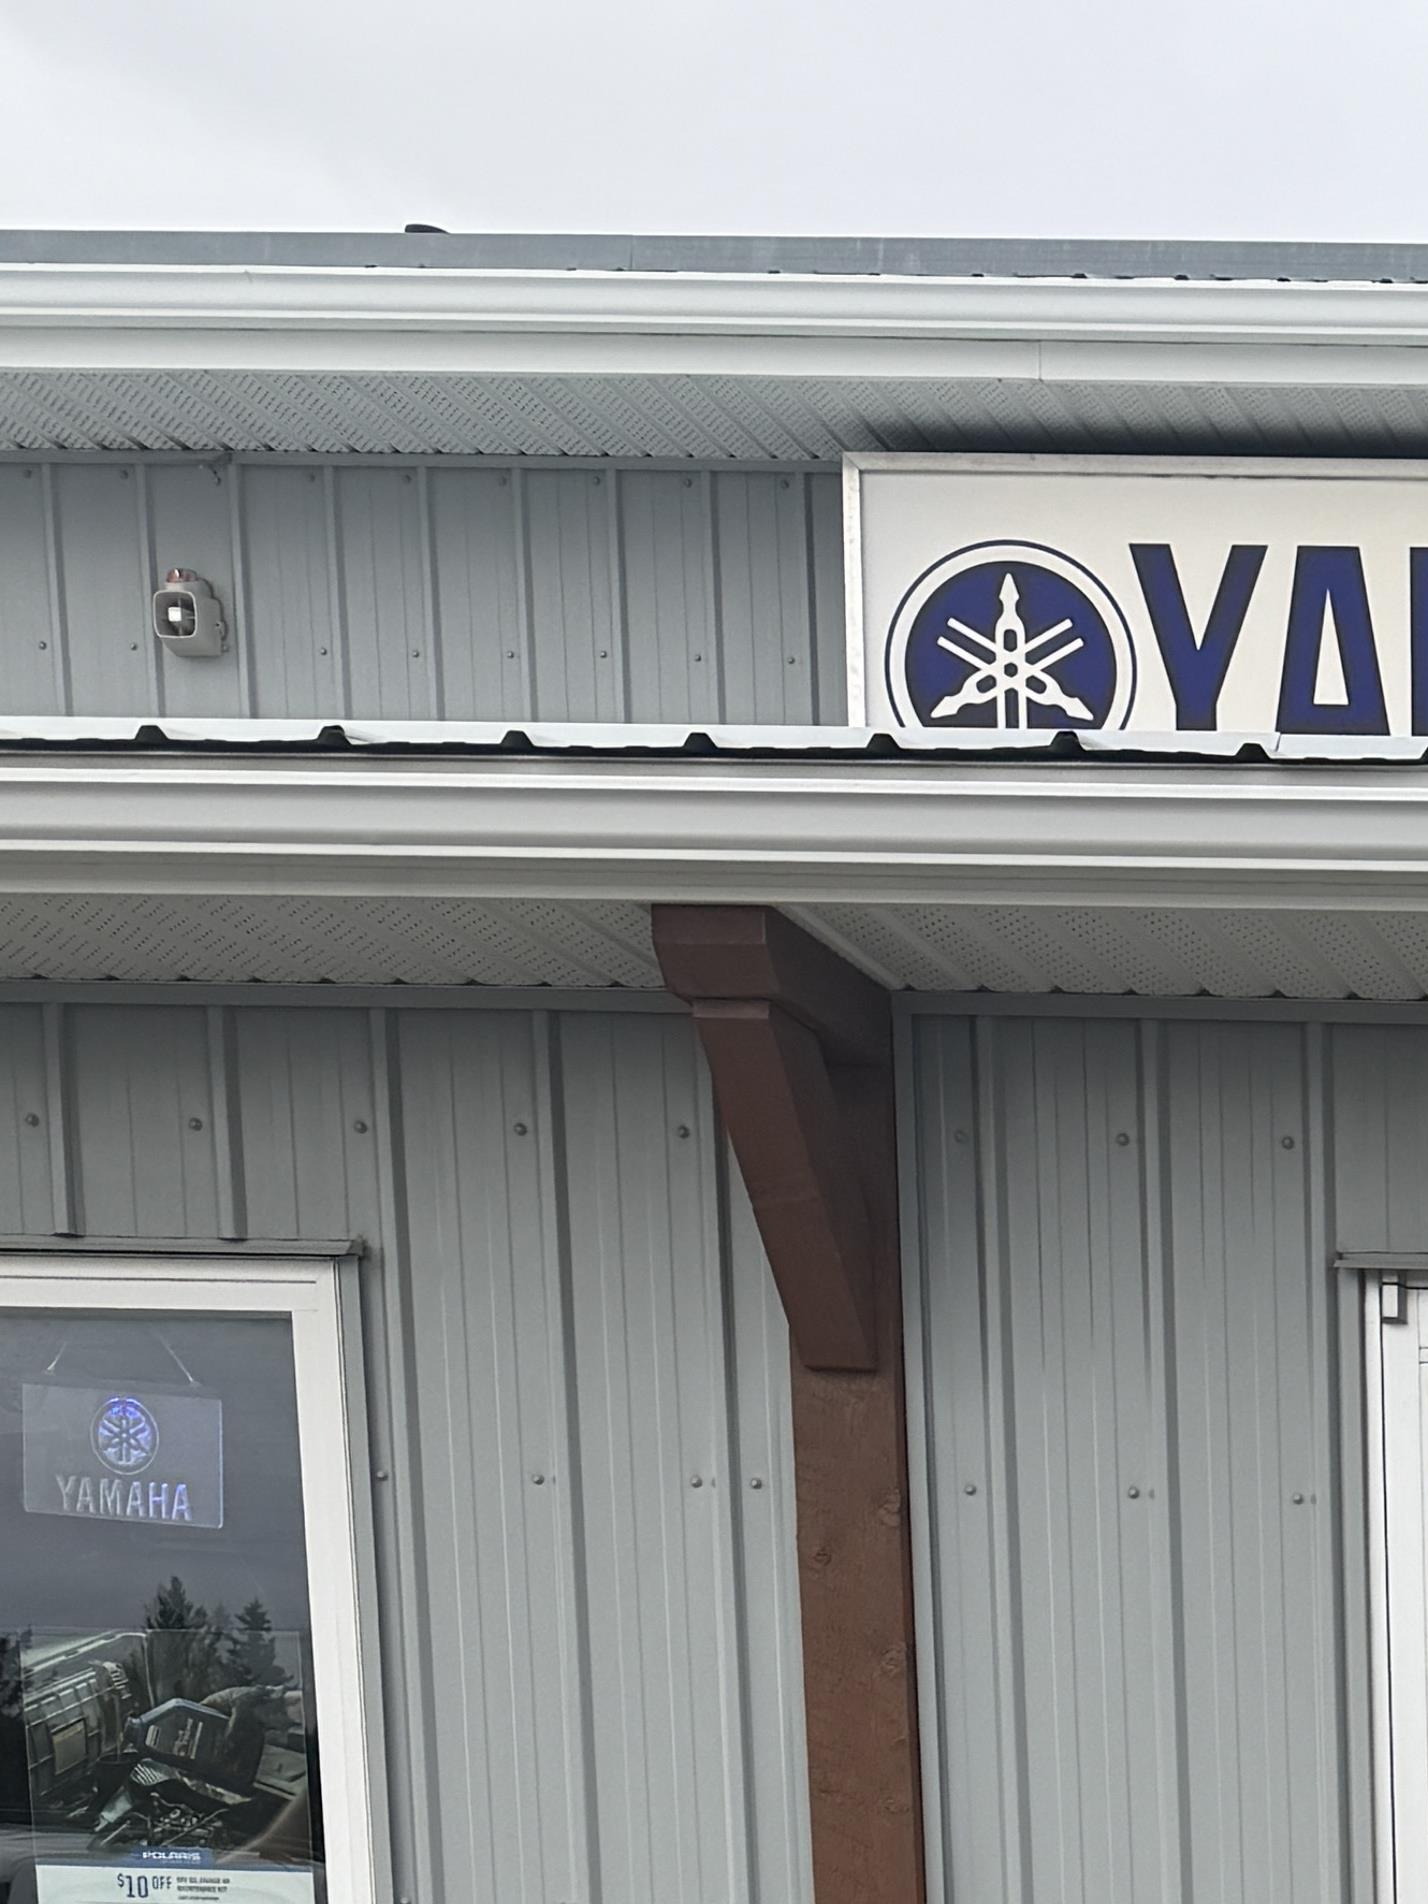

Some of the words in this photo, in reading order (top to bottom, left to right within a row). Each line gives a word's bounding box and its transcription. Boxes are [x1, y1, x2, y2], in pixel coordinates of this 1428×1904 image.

[56, 1474, 192, 1521] YAMAHA
[117, 1874, 148, 1898] $10
[152, 1877, 172, 1890] OFF
